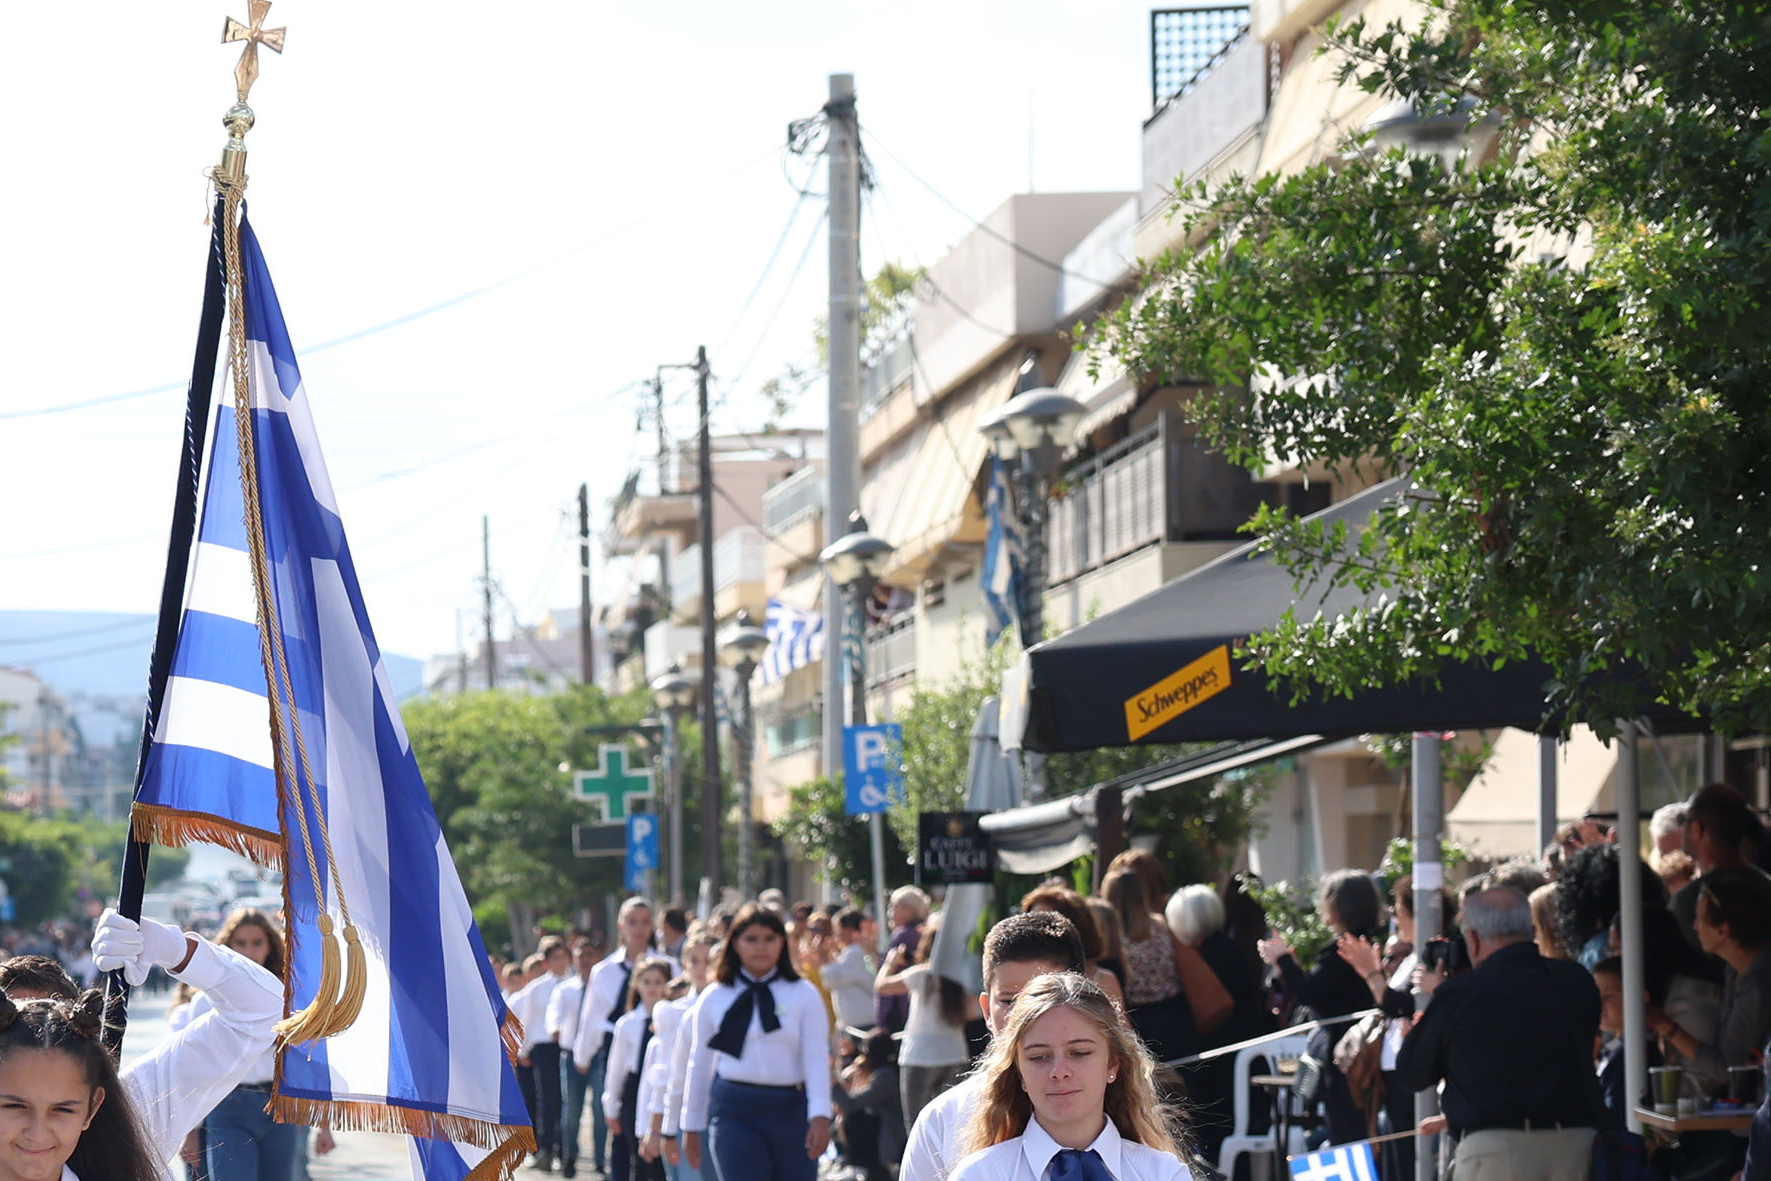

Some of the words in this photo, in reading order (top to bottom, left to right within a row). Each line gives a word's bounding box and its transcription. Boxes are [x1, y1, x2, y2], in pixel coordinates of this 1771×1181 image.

[1136, 666, 1218, 723] Schweppes
[856, 731, 885, 772] P
[633, 818, 652, 842] P
[923, 849, 988, 872] LUIGI
